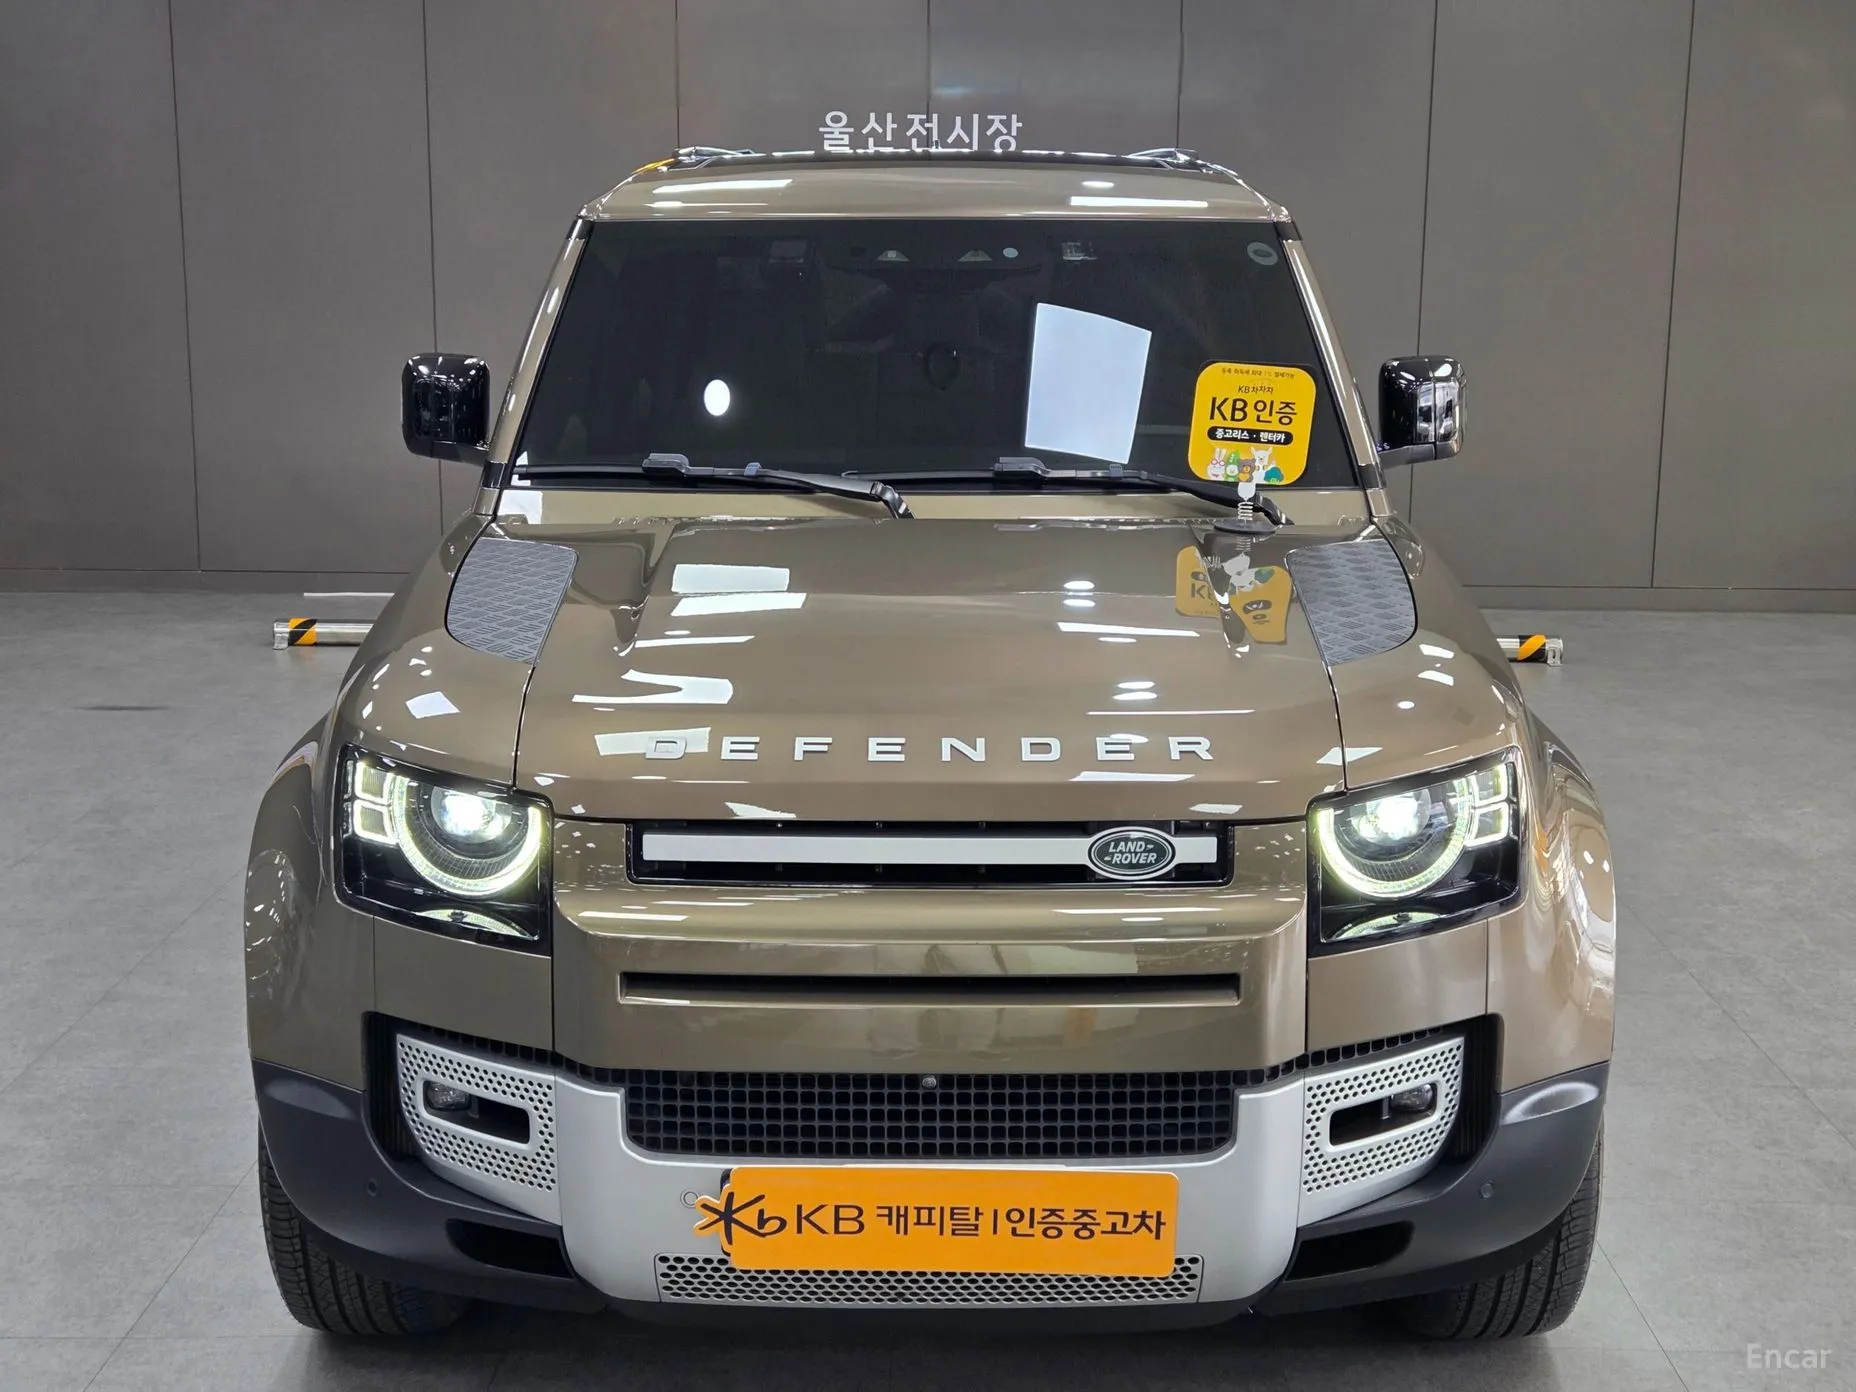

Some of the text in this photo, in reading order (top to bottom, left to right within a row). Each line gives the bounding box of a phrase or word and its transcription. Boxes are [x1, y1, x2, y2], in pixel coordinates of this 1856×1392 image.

[818, 110, 1023, 151] 울산전시장
[1209, 396, 1297, 426] KB 인증
[1215, 428, 1250, 440] 중고리스
[1259, 431, 1286, 443] 렌터카
[645, 736, 1214, 761] DEFENDER
[1109, 841, 1145, 853] LAND
[1111, 852, 1157, 864] ROVER
[796, 1204, 866, 1235] KB
[876, 1205, 984, 1237] 캐피탈
[1005, 1207, 1167, 1240] 인증중고차
